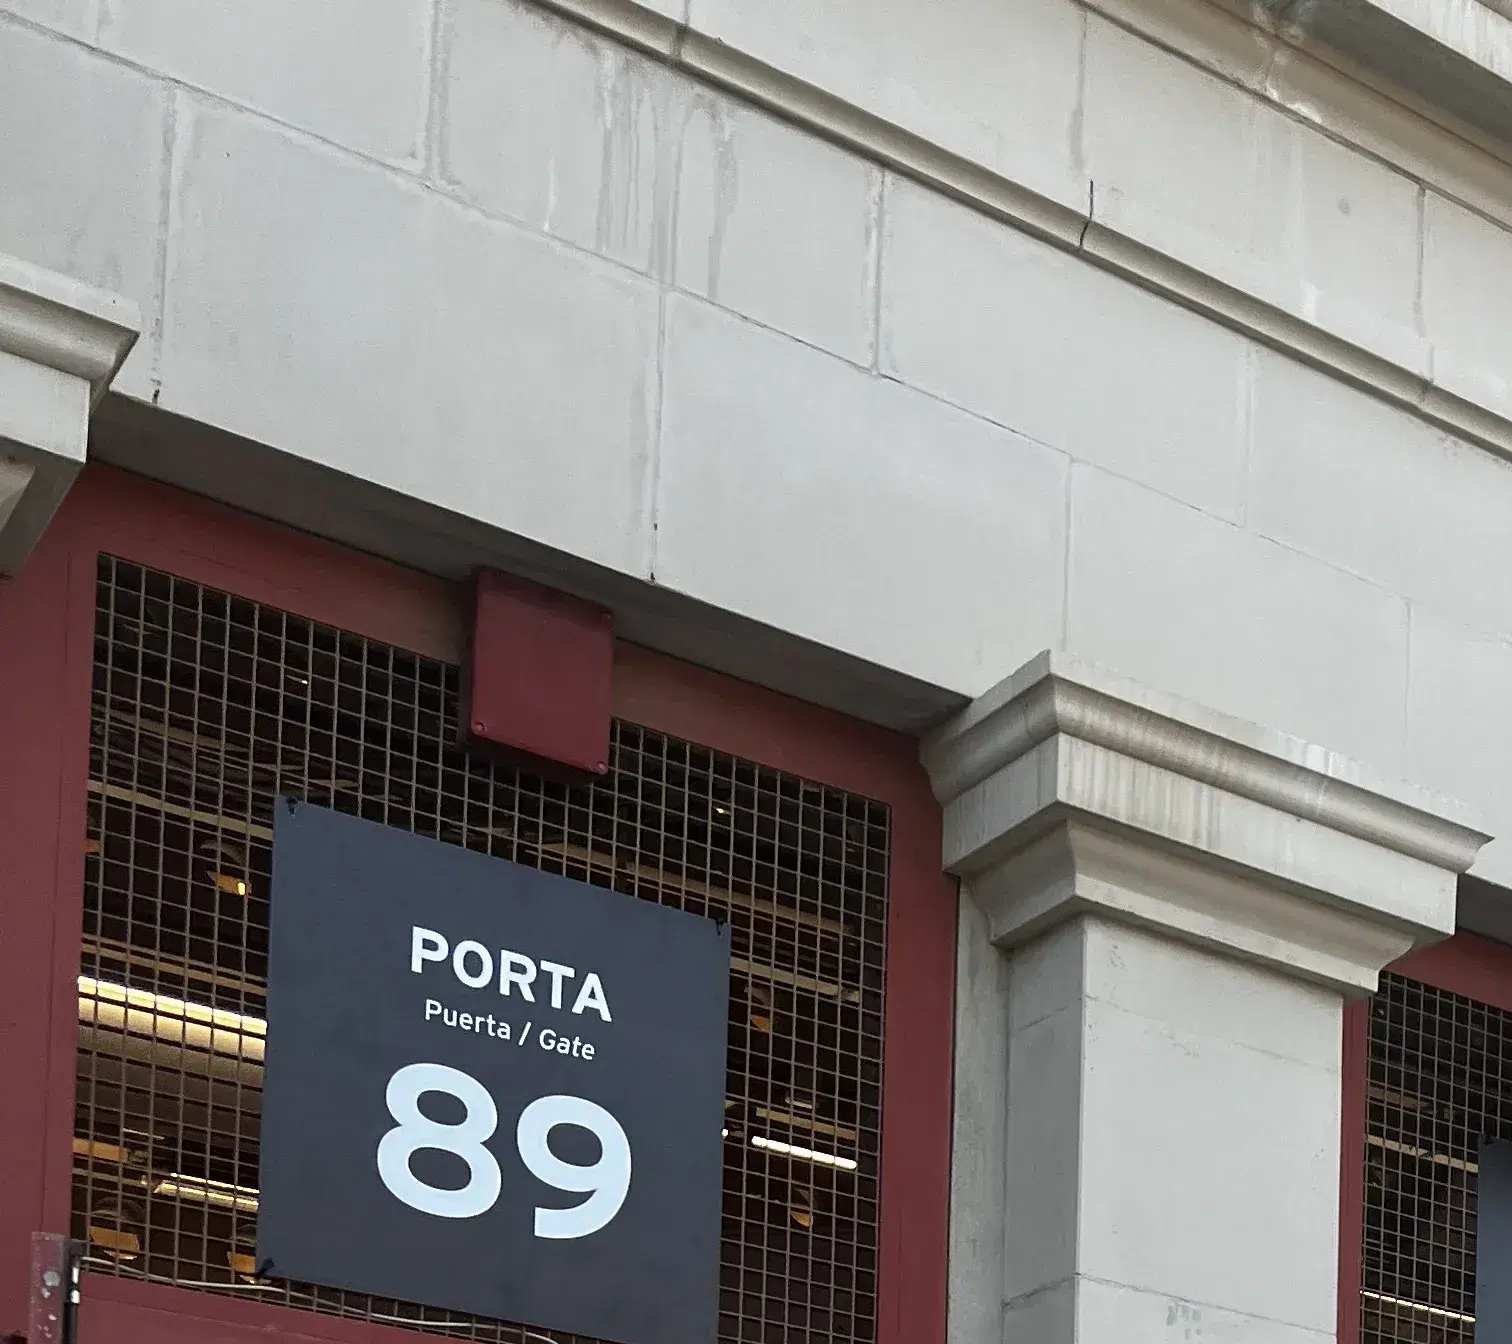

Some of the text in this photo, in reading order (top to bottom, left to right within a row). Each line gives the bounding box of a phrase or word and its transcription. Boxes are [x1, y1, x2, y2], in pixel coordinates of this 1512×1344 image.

[410, 925, 613, 1023] PORTA
[424, 998, 595, 1061] Puerta / Gate
[376, 1062, 632, 1239] 89
